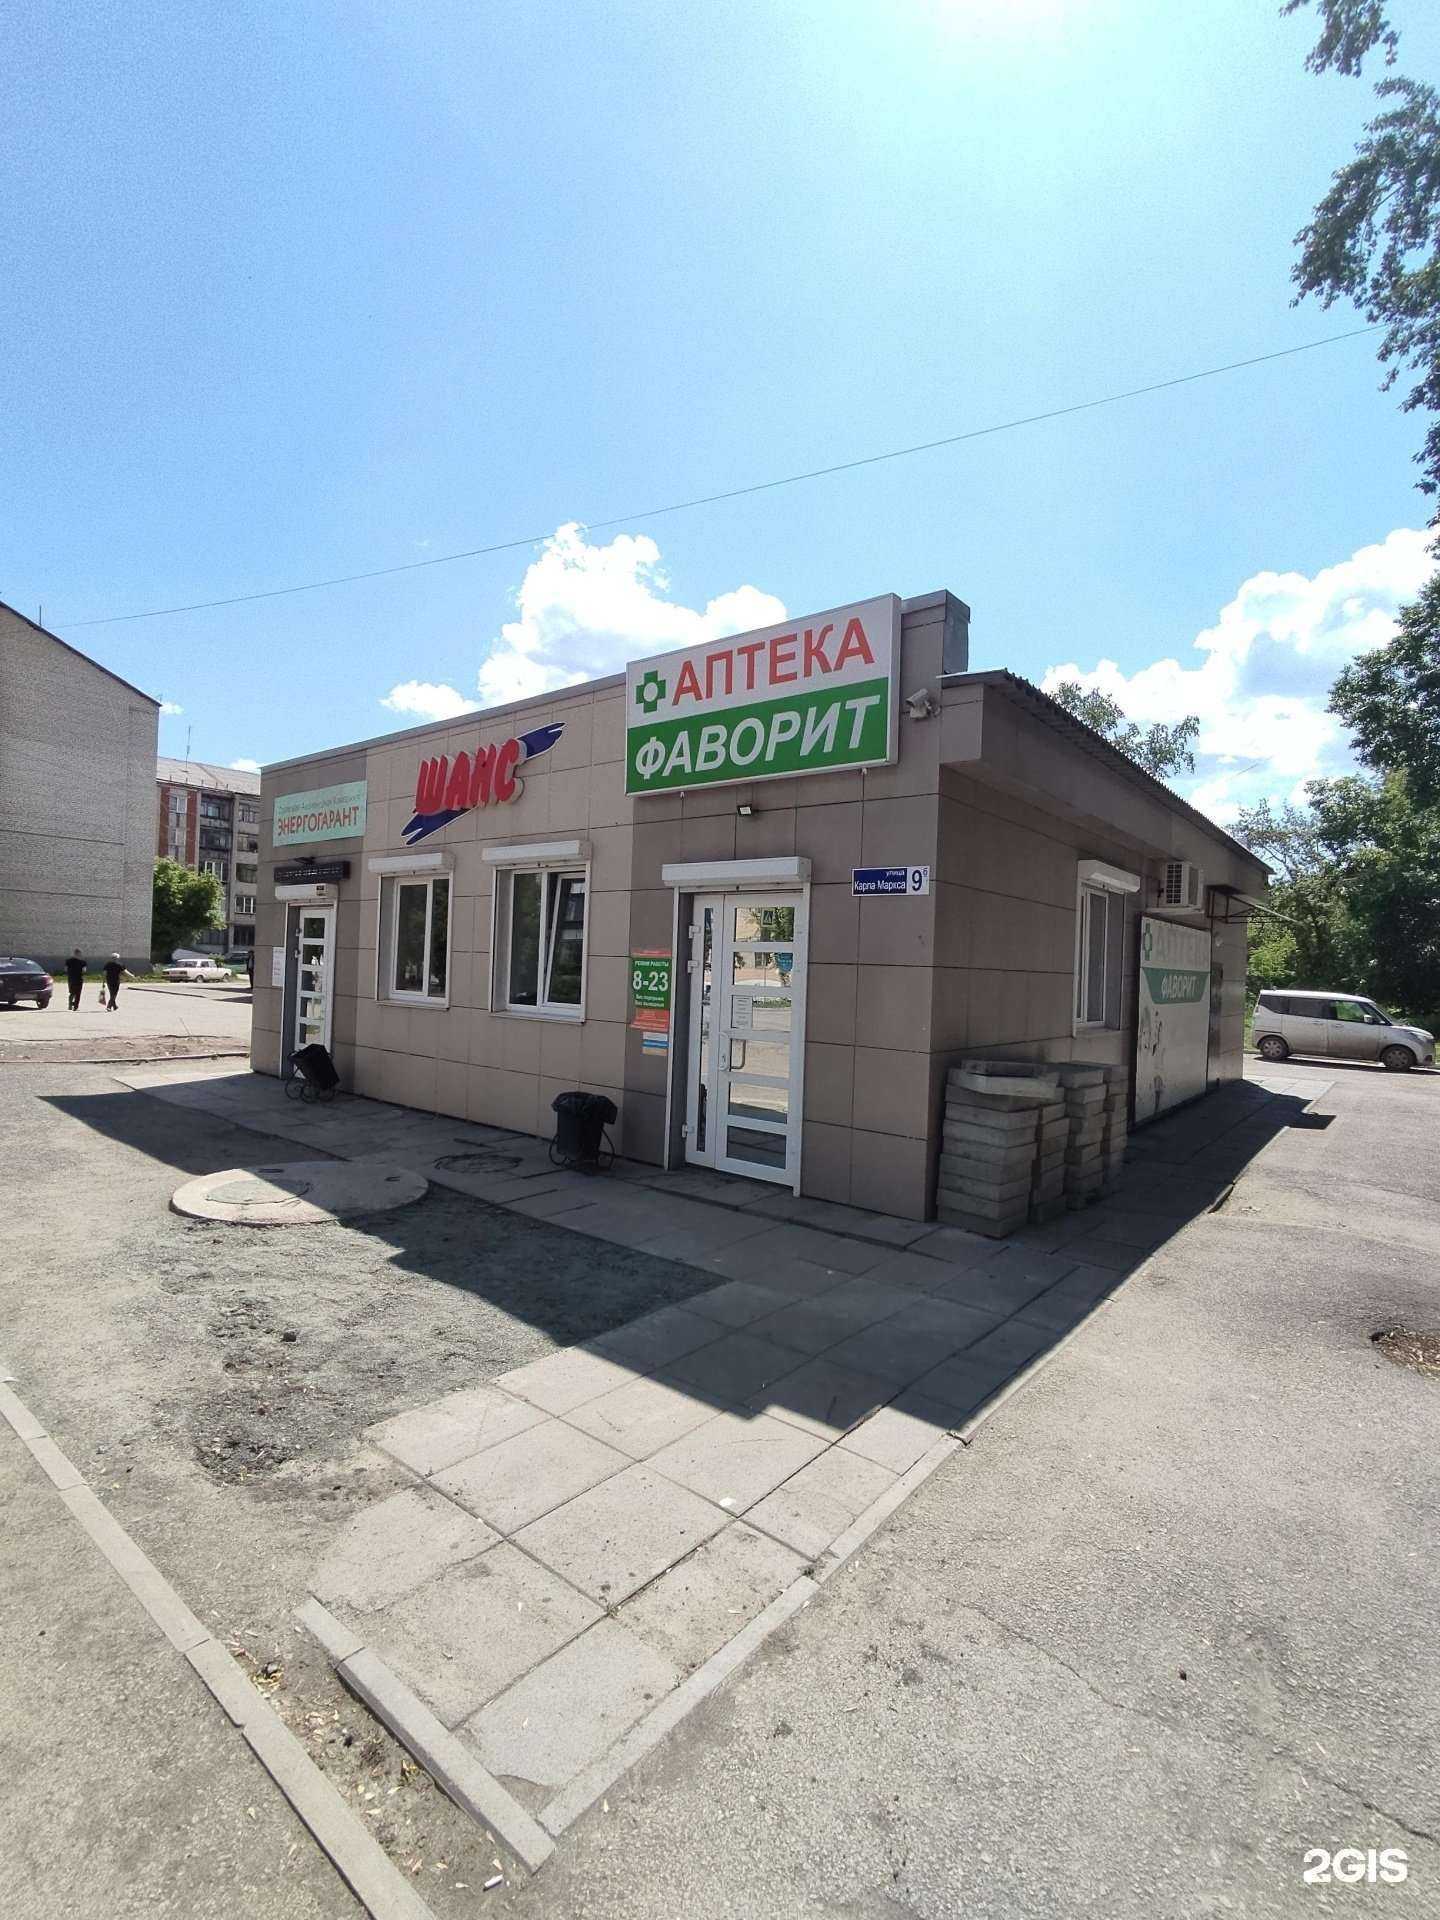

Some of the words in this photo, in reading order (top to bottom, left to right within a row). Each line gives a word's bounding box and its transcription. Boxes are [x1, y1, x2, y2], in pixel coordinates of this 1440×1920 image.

[671, 617, 875, 706] АПТЕКА
[635, 694, 881, 780] ФАВОРИТ
[415, 738, 520, 815] ШАНС
[278, 805, 360, 836] ЭНЕРГОГАРАНТ
[877, 880, 906, 892] Маркса
[632, 970, 669, 992] 8-23
[1161, 975, 1197, 999] ФАВОРИТ
